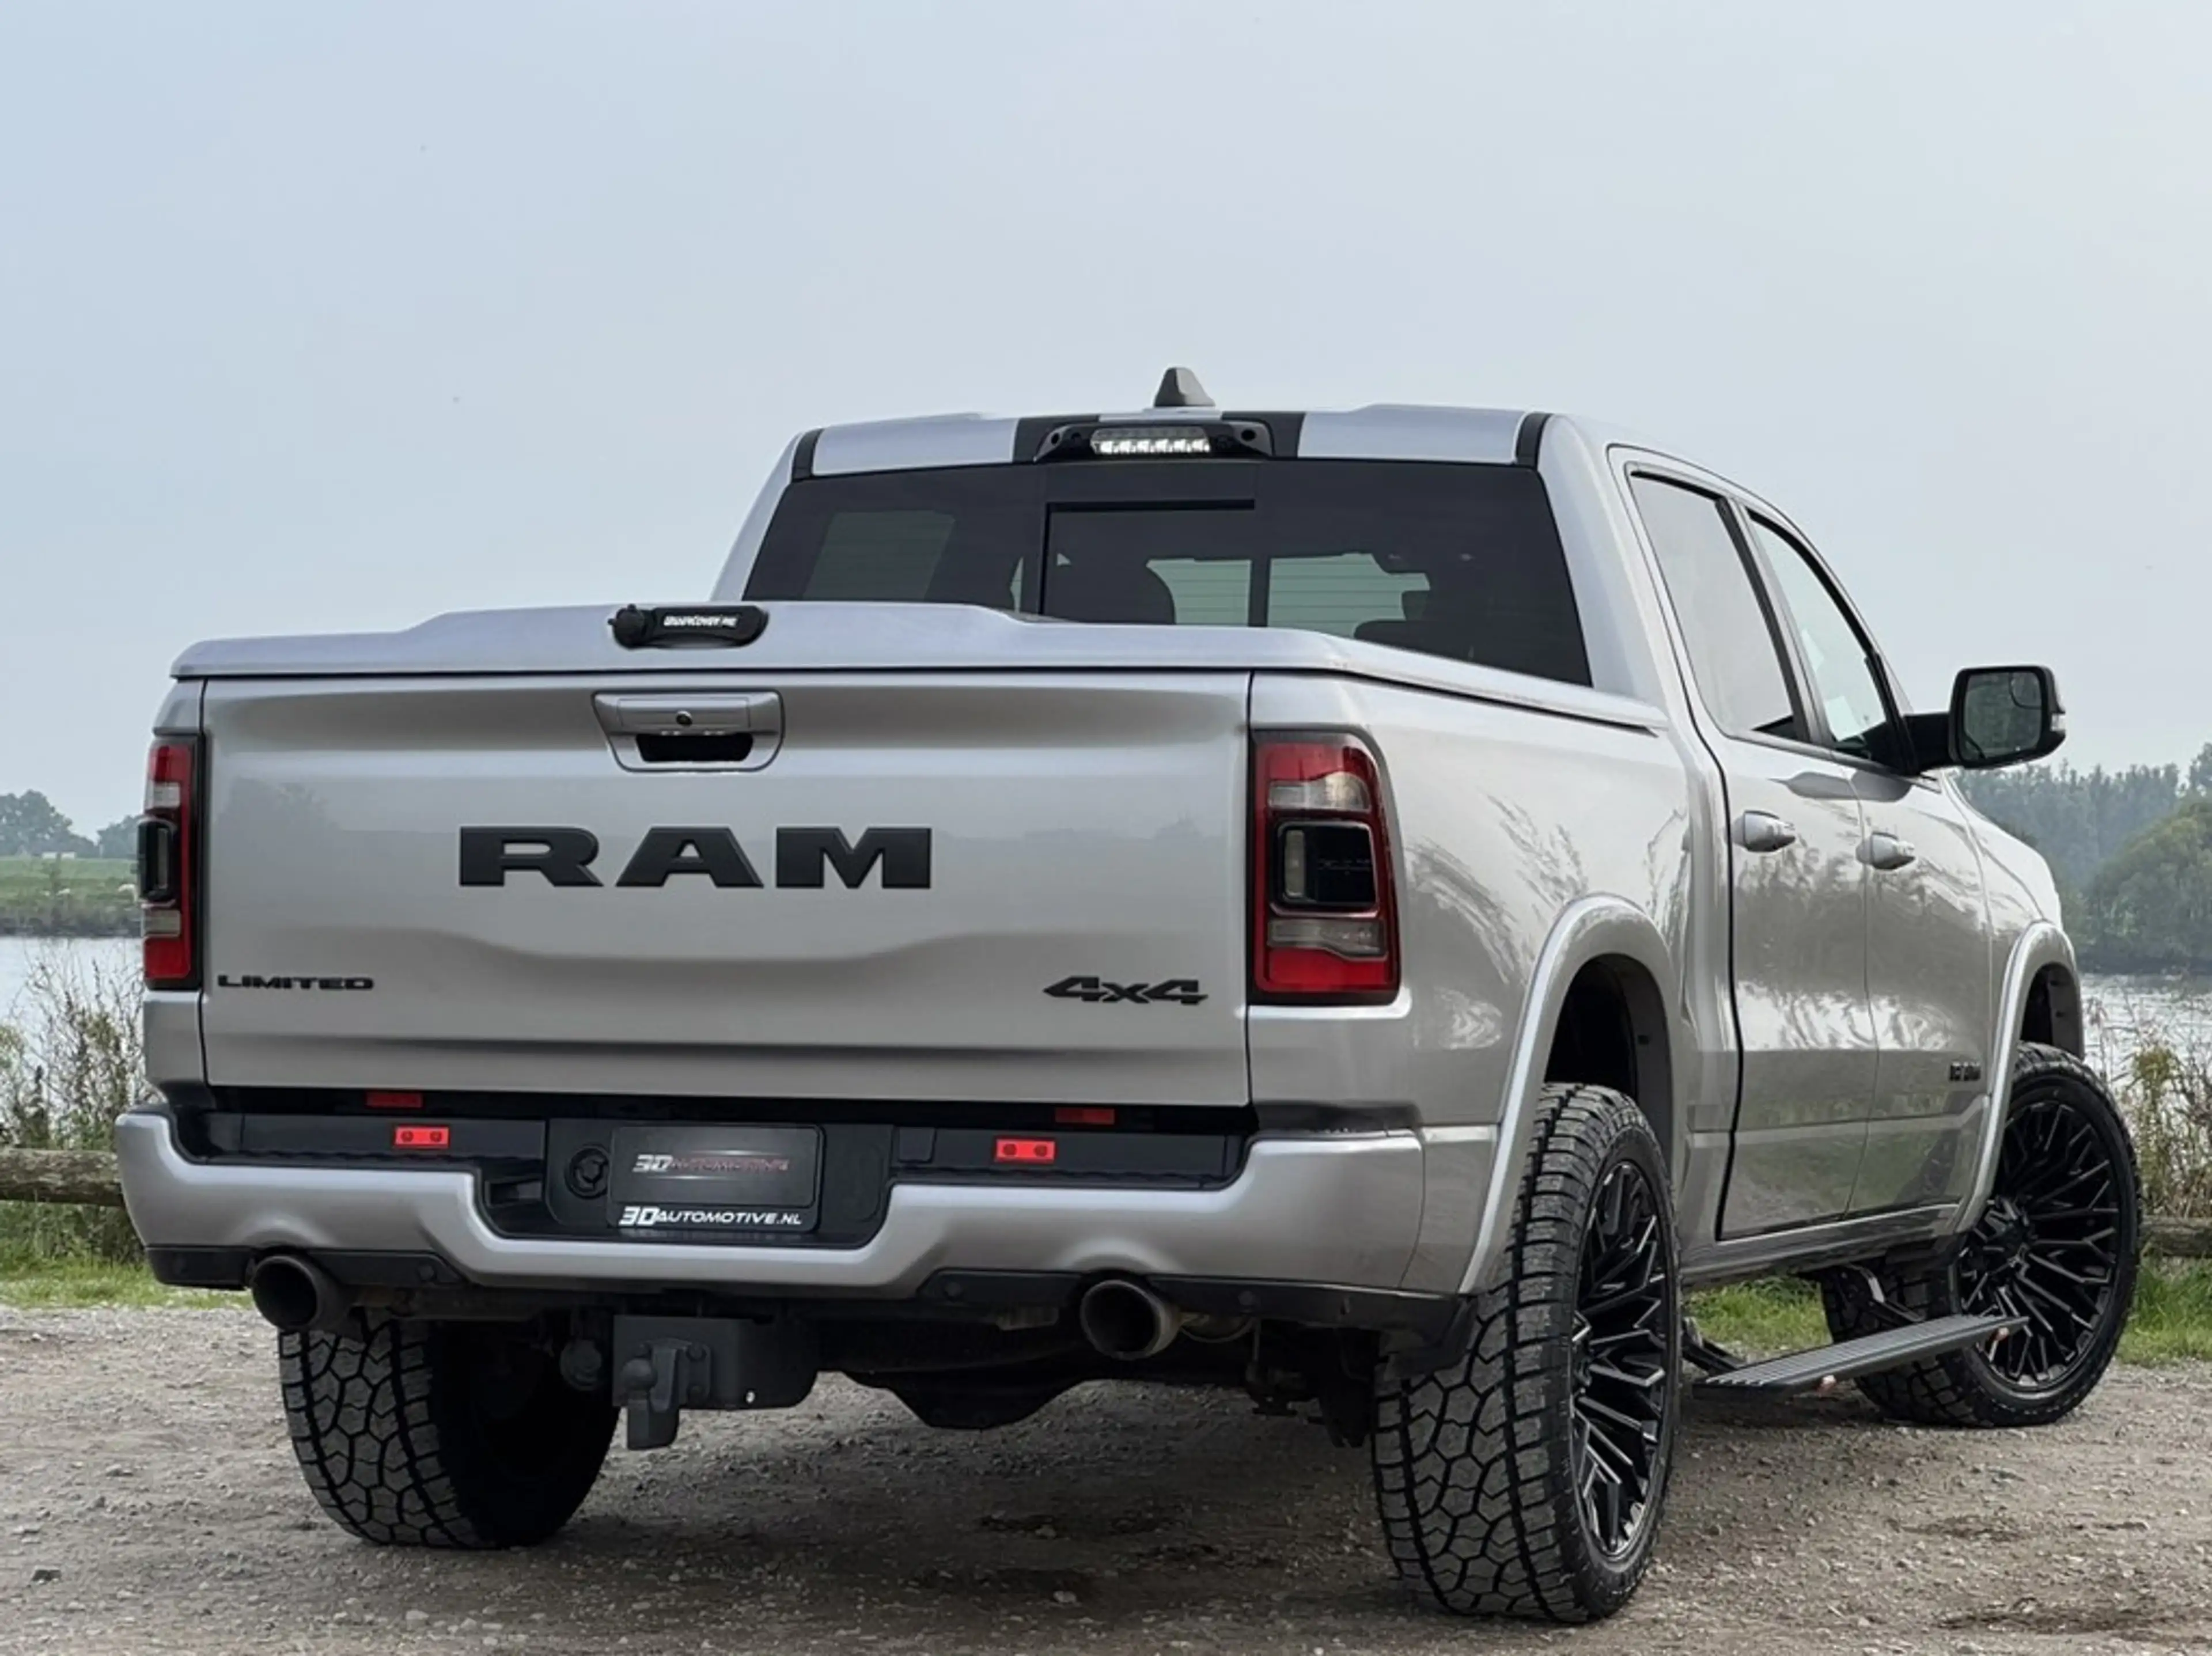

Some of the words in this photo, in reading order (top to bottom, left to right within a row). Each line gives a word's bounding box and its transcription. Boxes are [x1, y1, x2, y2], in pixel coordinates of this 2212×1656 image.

[459, 827, 931, 889] RAM
[218, 974, 374, 990] LIMITED
[1042, 976, 1209, 1006] 4x4
[618, 1206, 802, 1226] 3DAUTOMOTIVE.NL
